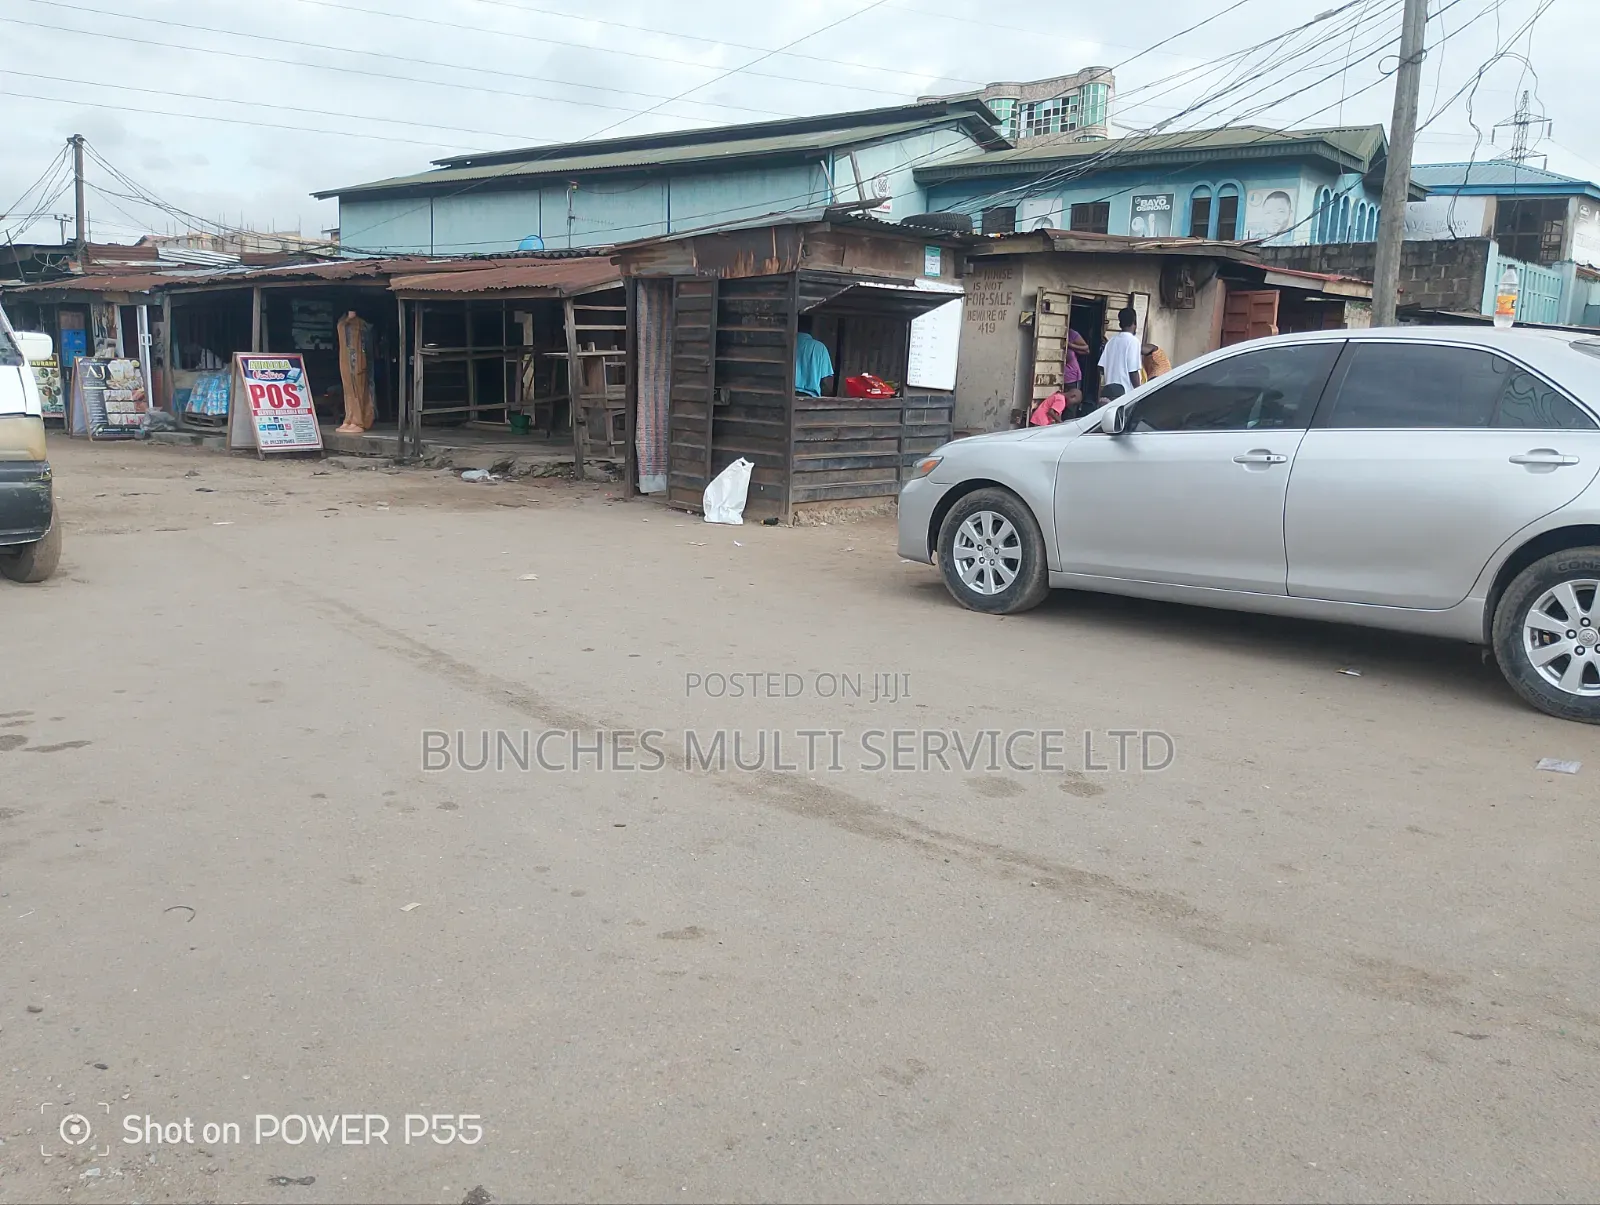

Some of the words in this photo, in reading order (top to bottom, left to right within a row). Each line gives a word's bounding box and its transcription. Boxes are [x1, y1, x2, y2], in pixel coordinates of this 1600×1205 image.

[1140, 199, 1167, 207] BAYO
[973, 282, 981, 291] IS
[984, 281, 1004, 291] NOT
[967, 309, 996, 322] BEWARE
[998, 309, 1008, 321] OF
[978, 322, 996, 335] 419
[249, 384, 301, 408] POS
